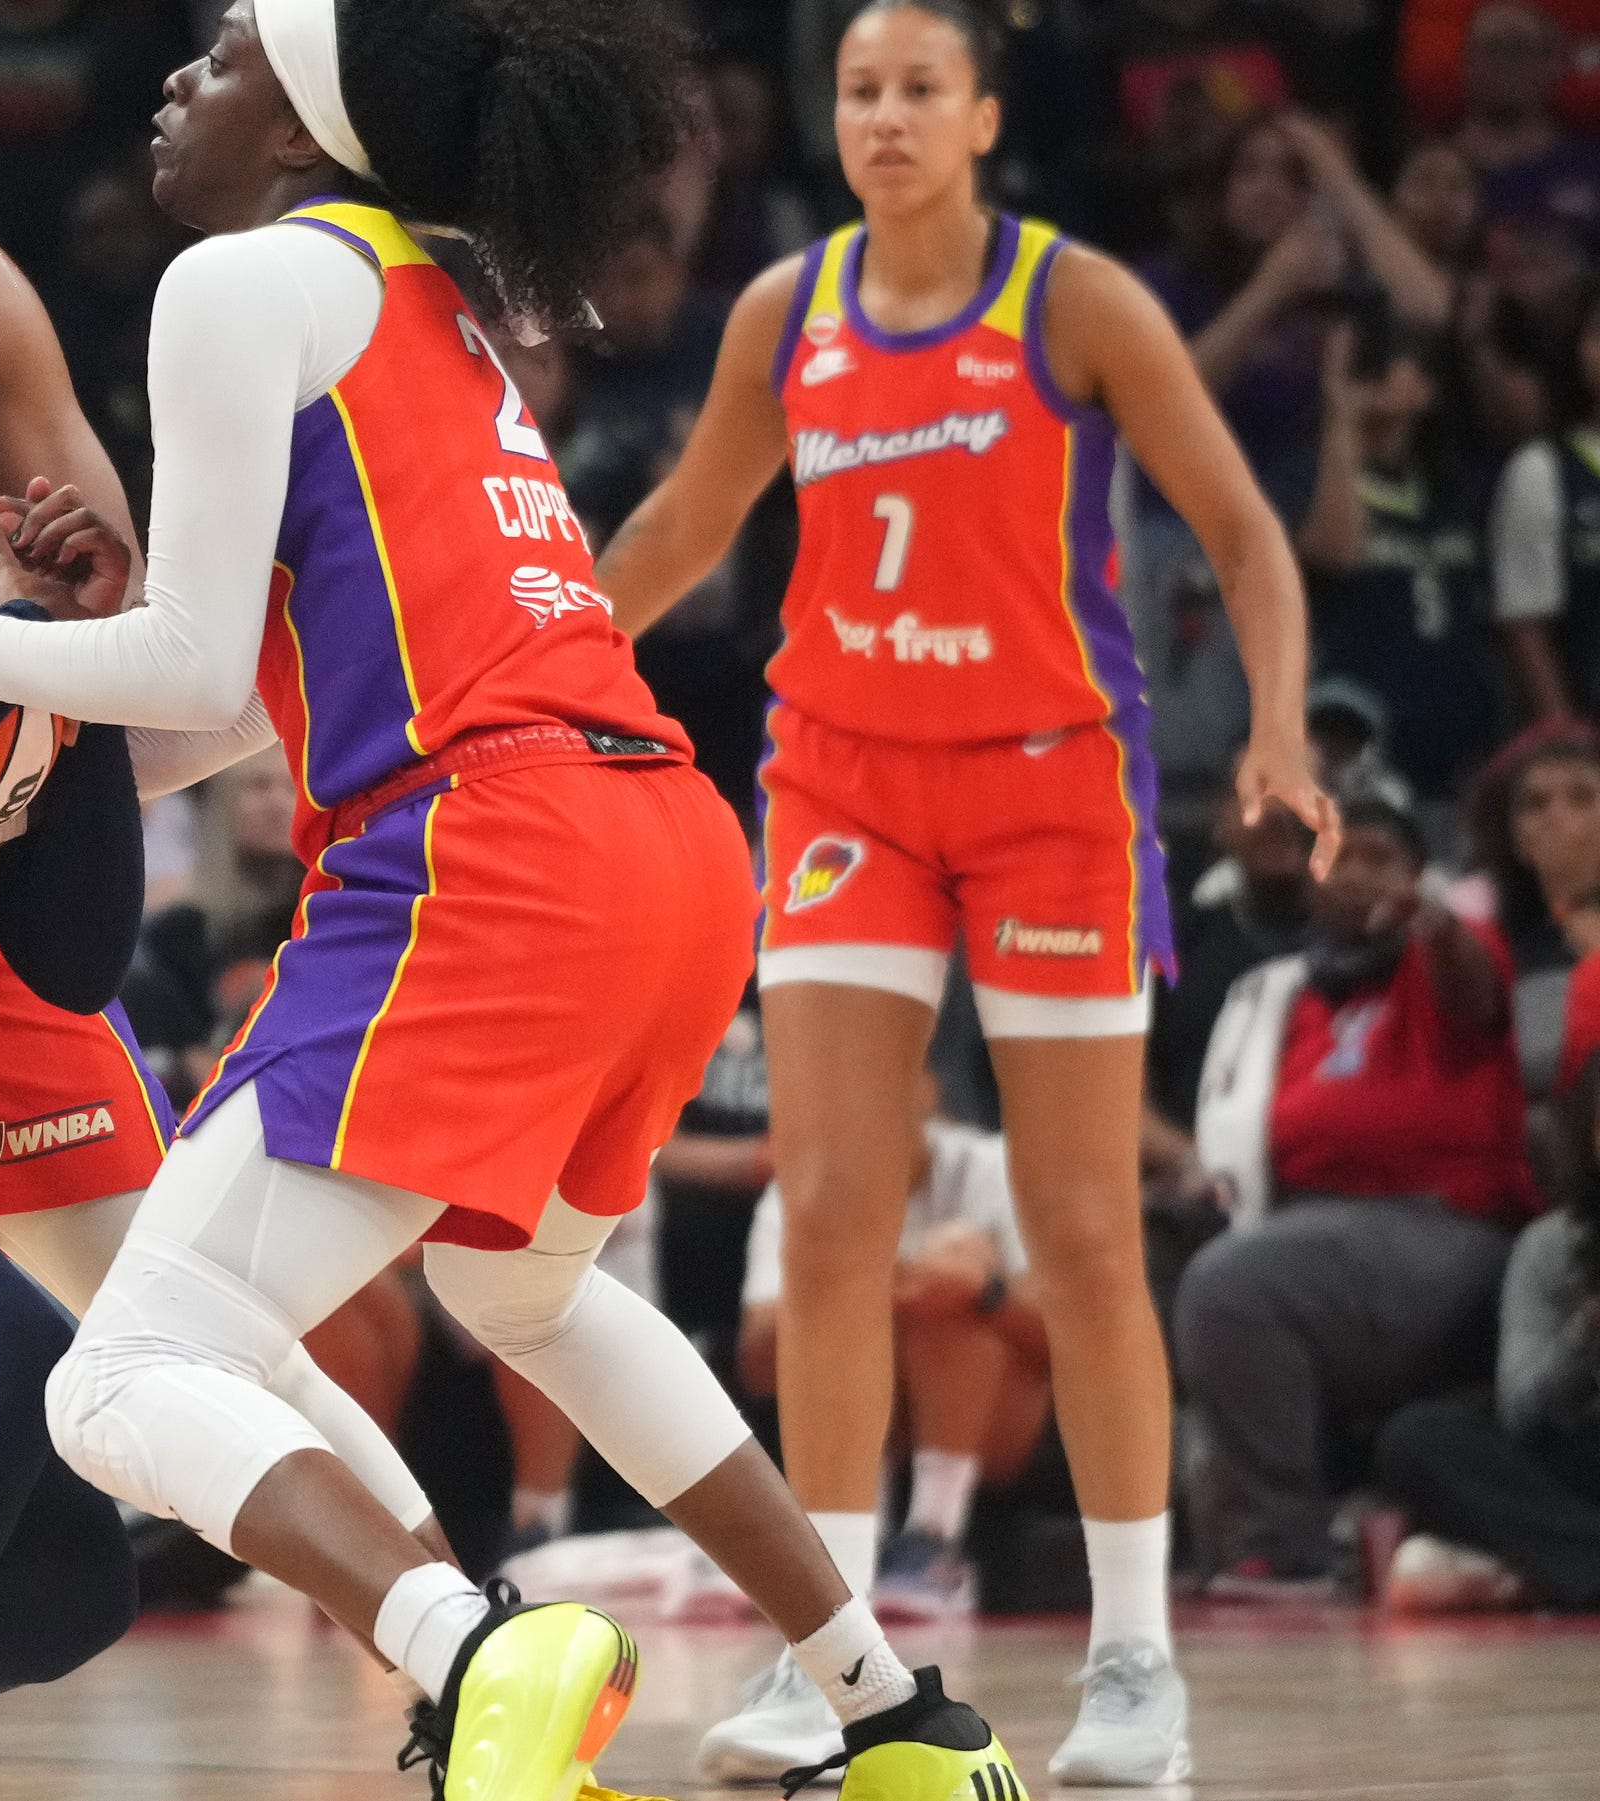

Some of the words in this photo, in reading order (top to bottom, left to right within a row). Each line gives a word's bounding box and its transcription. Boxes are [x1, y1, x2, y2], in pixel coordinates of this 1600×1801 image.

[455, 312, 550, 464] 2
[795, 411, 1008, 484] Mercury
[481, 476, 592, 556] COPP
[1015, 928, 1101, 955] WNBA
[6, 1107, 115, 1156] WNBA
